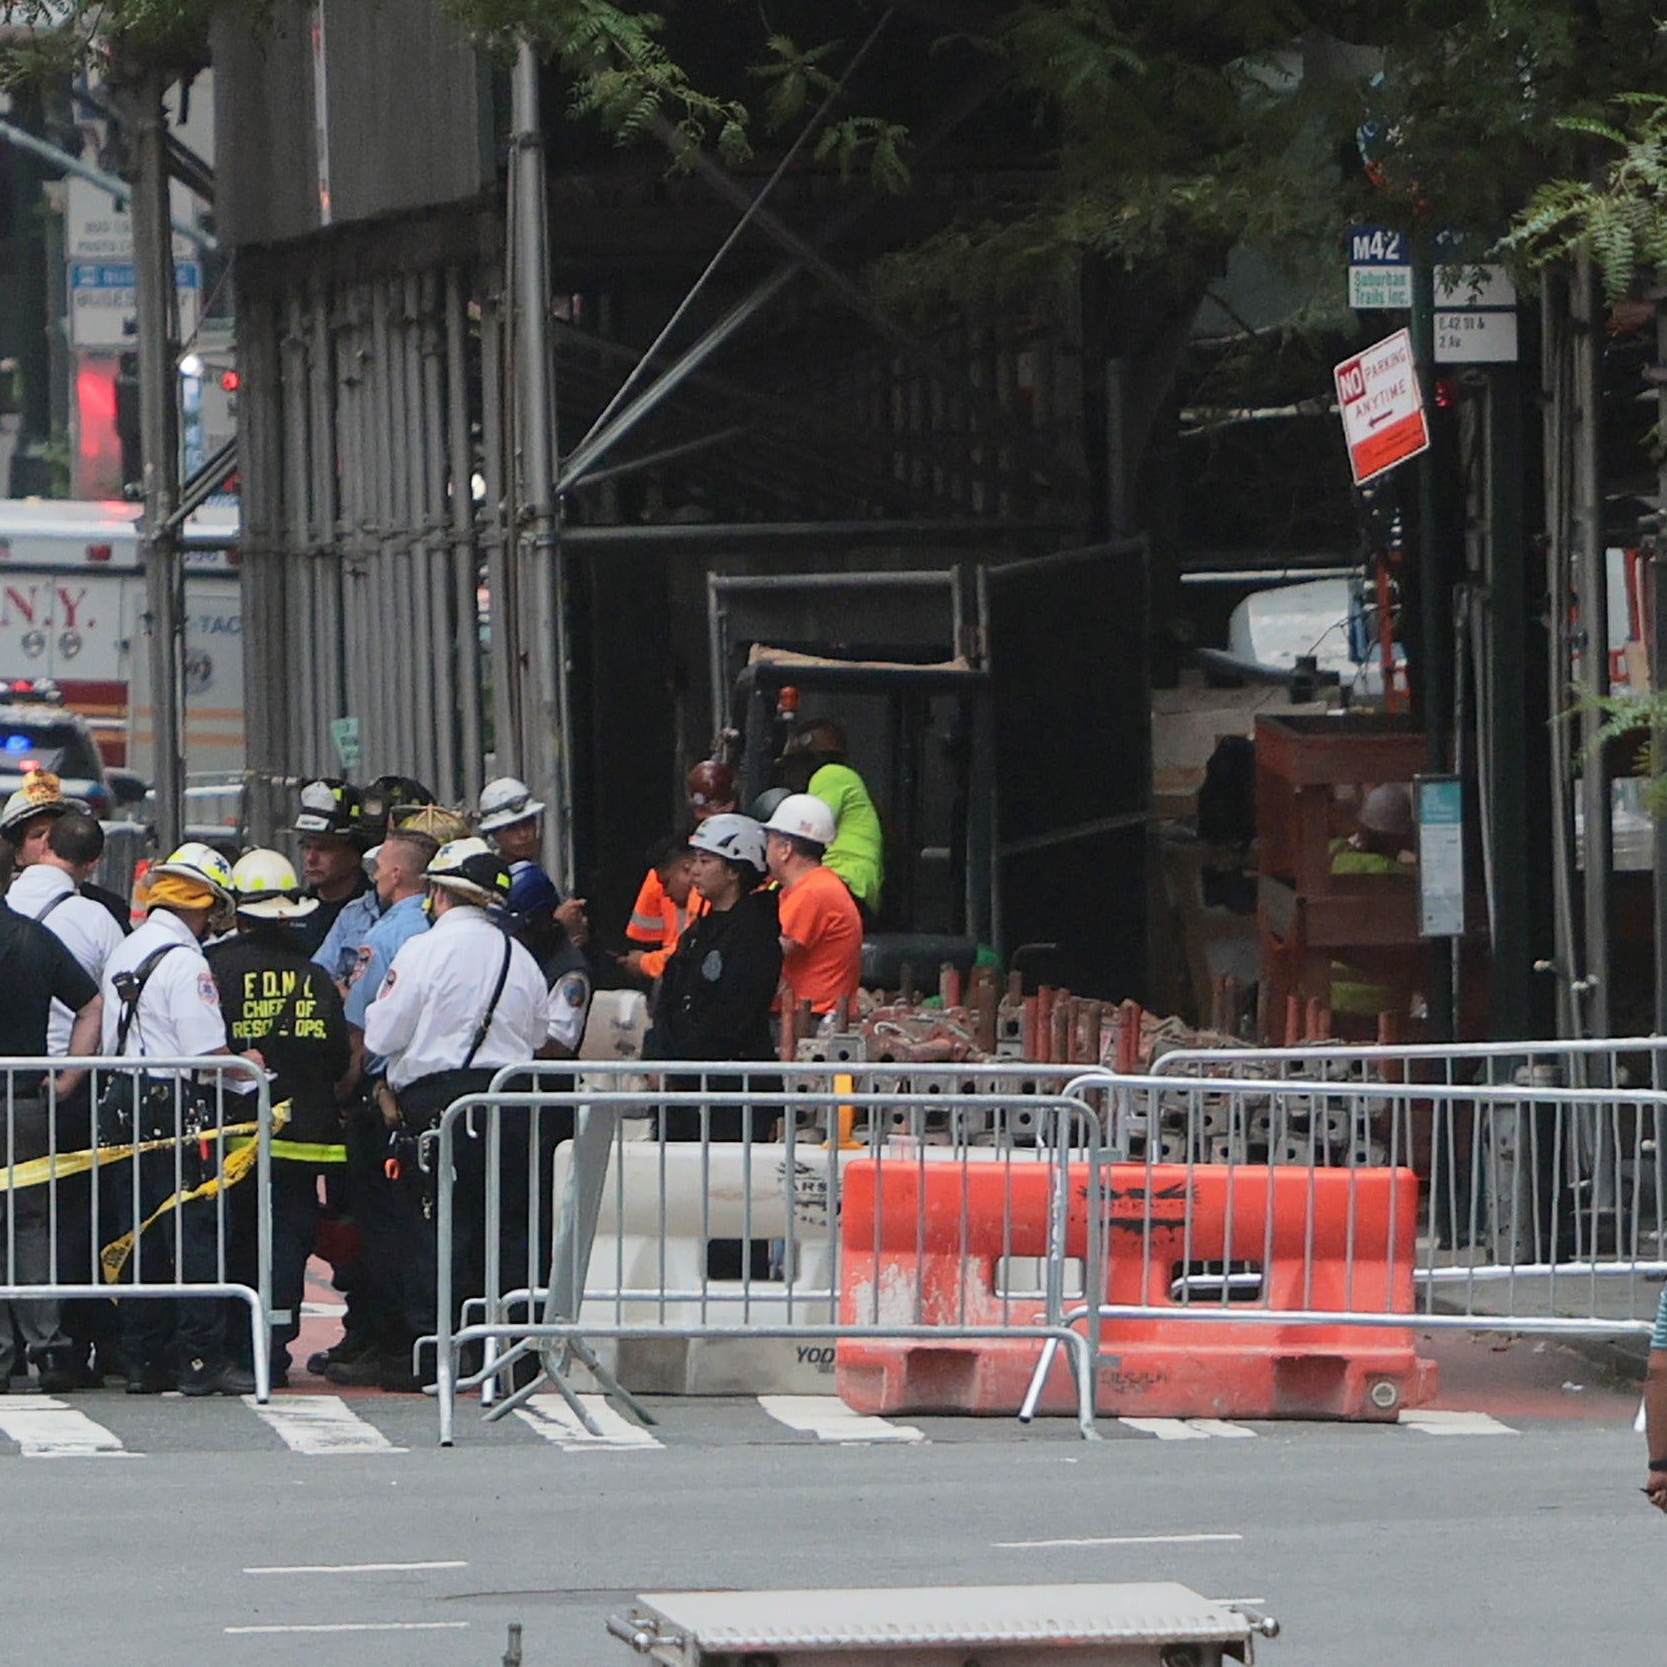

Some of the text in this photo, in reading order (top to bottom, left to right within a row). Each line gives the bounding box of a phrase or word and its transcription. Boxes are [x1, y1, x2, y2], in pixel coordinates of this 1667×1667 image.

[1353, 230, 1400, 261] M42
[1339, 346, 1407, 403] NO PARKING
[1355, 378, 1407, 419] ANYTIME
[242, 998, 317, 1019] CHIEF OF
[294, 1019, 327, 1039] OPS.
[796, 1345, 836, 1363] YOD
